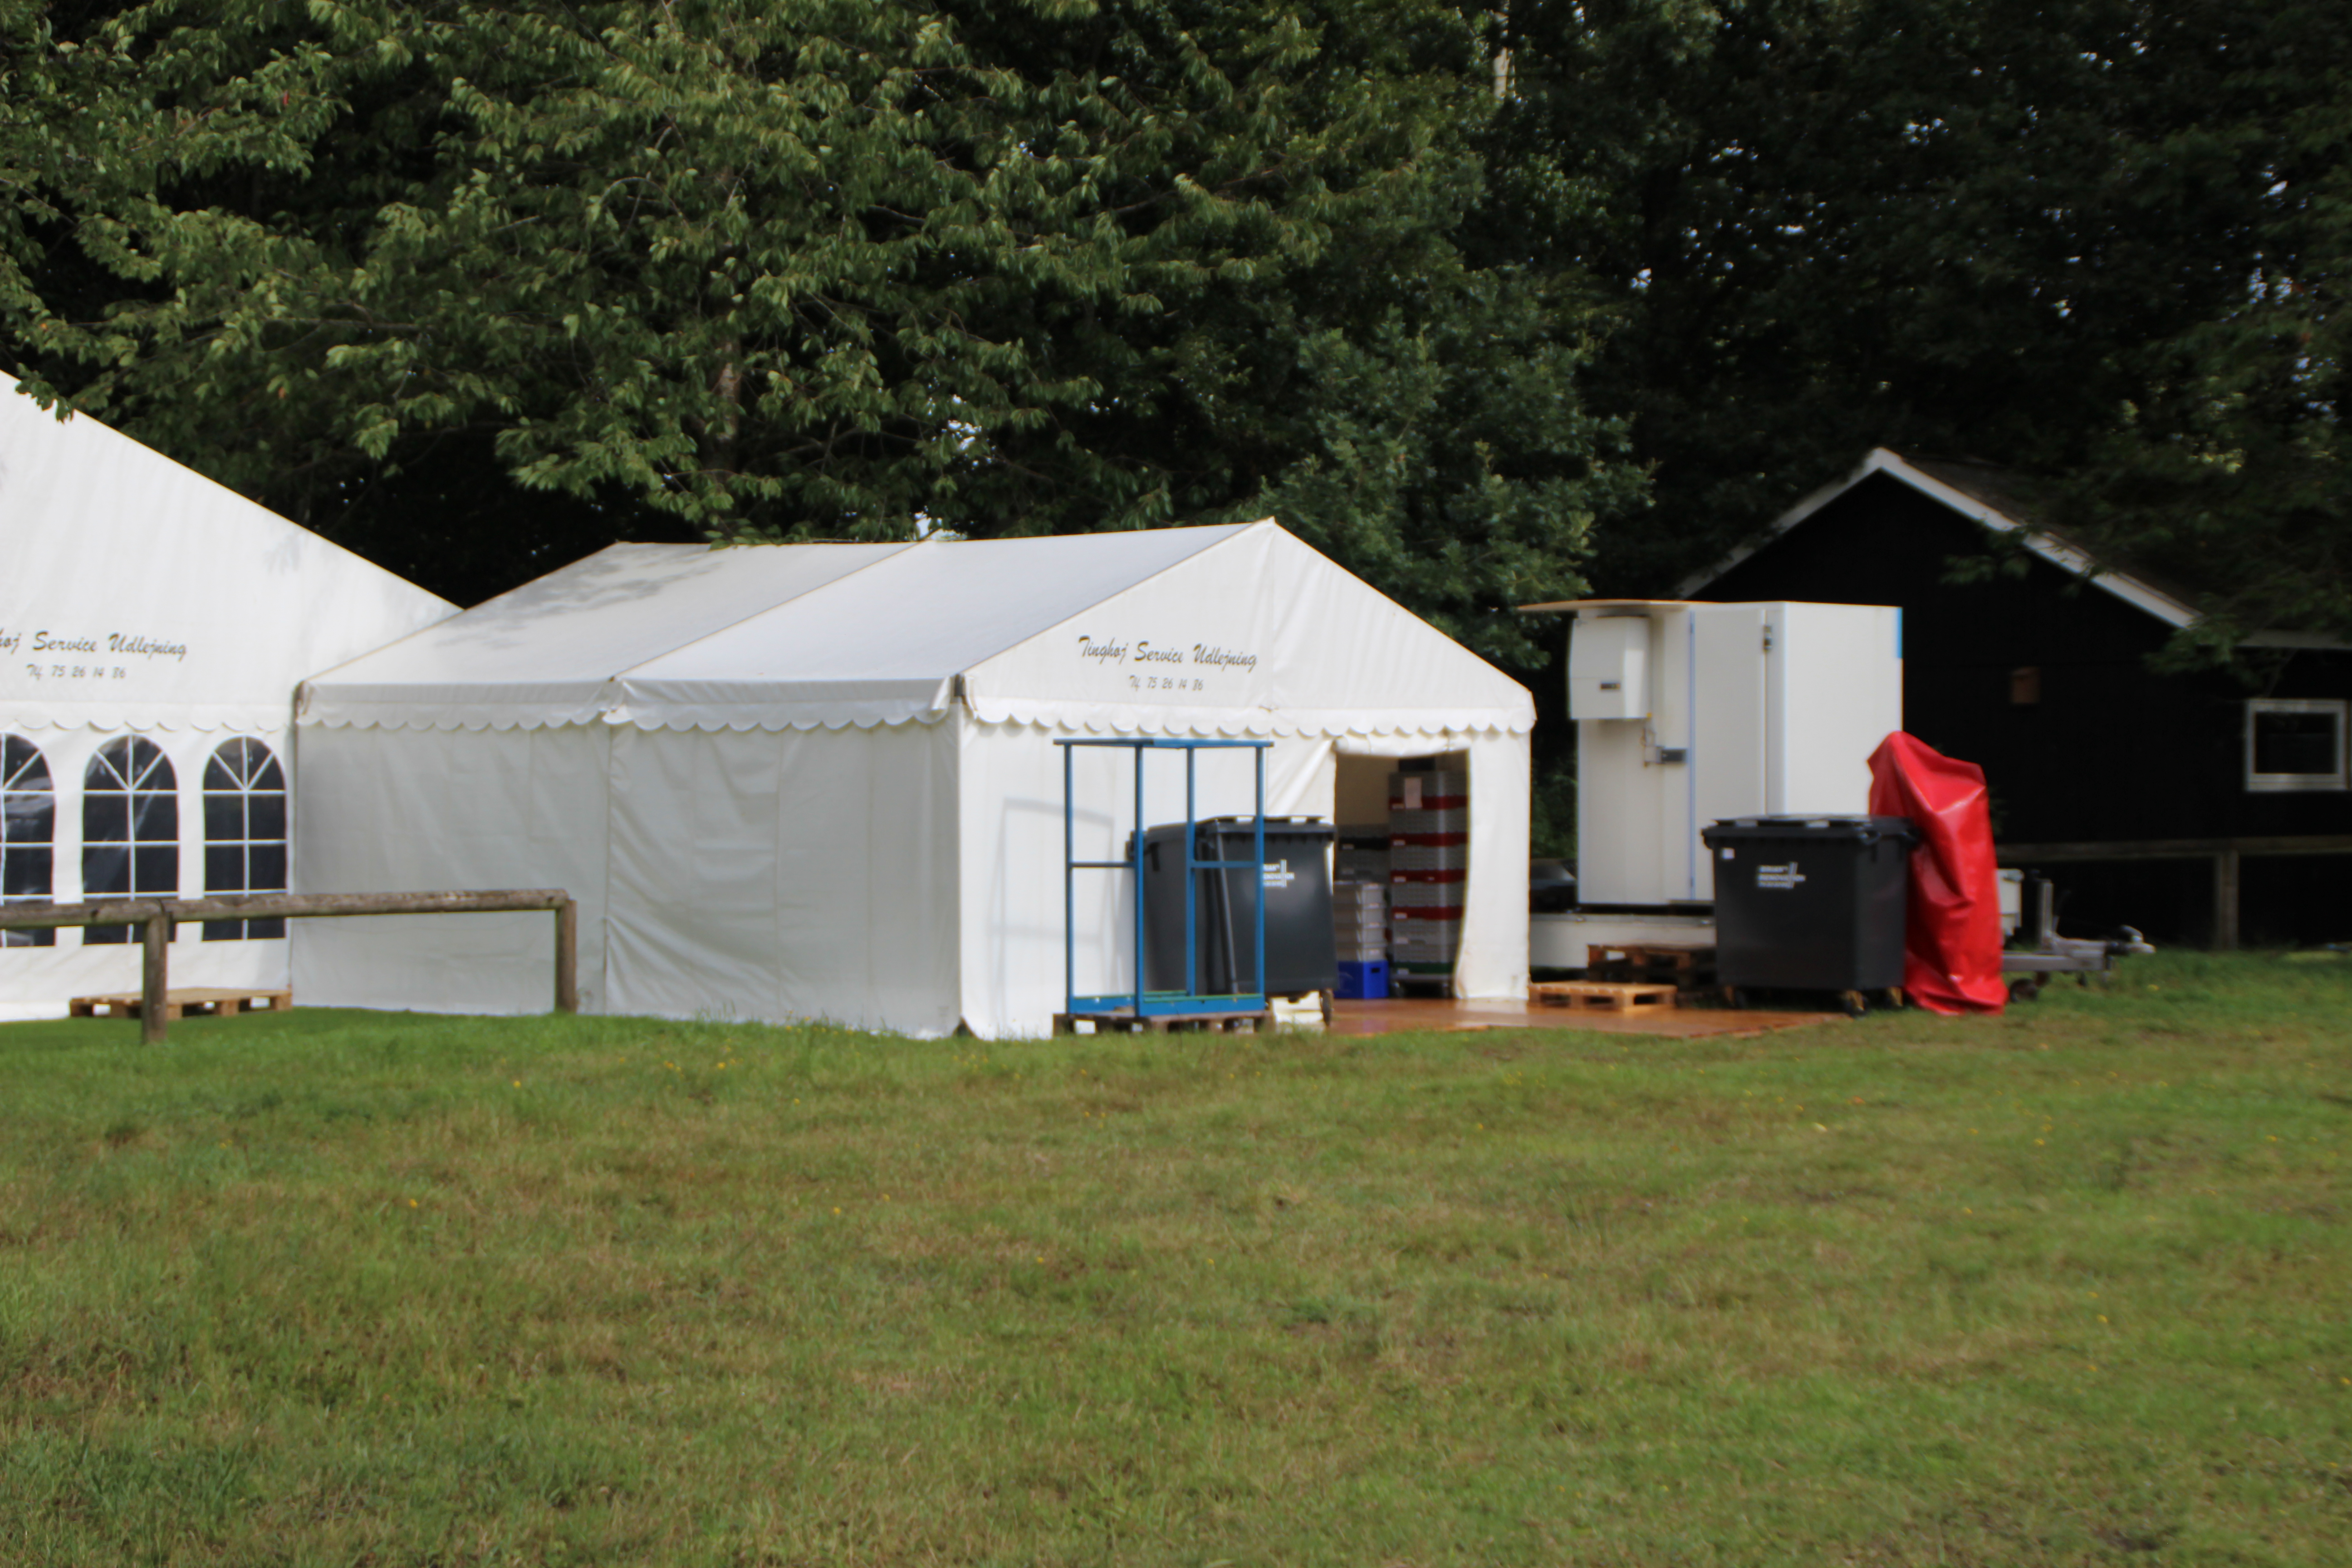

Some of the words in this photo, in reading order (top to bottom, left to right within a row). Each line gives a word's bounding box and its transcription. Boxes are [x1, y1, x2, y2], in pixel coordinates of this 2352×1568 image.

[32, 630, 97, 652] Service
[108, 633, 186, 662] Udlejning
[1134, 641, 1184, 663] Service
[1194, 643, 1258, 672] Udlejning
[51, 665, 66, 677] 75
[71, 666, 86, 678] 26
[113, 667, 127, 679] 86
[1147, 676, 1157, 689] 75
[1161, 677, 1173, 690] 26
[1192, 679, 1204, 691] 86
